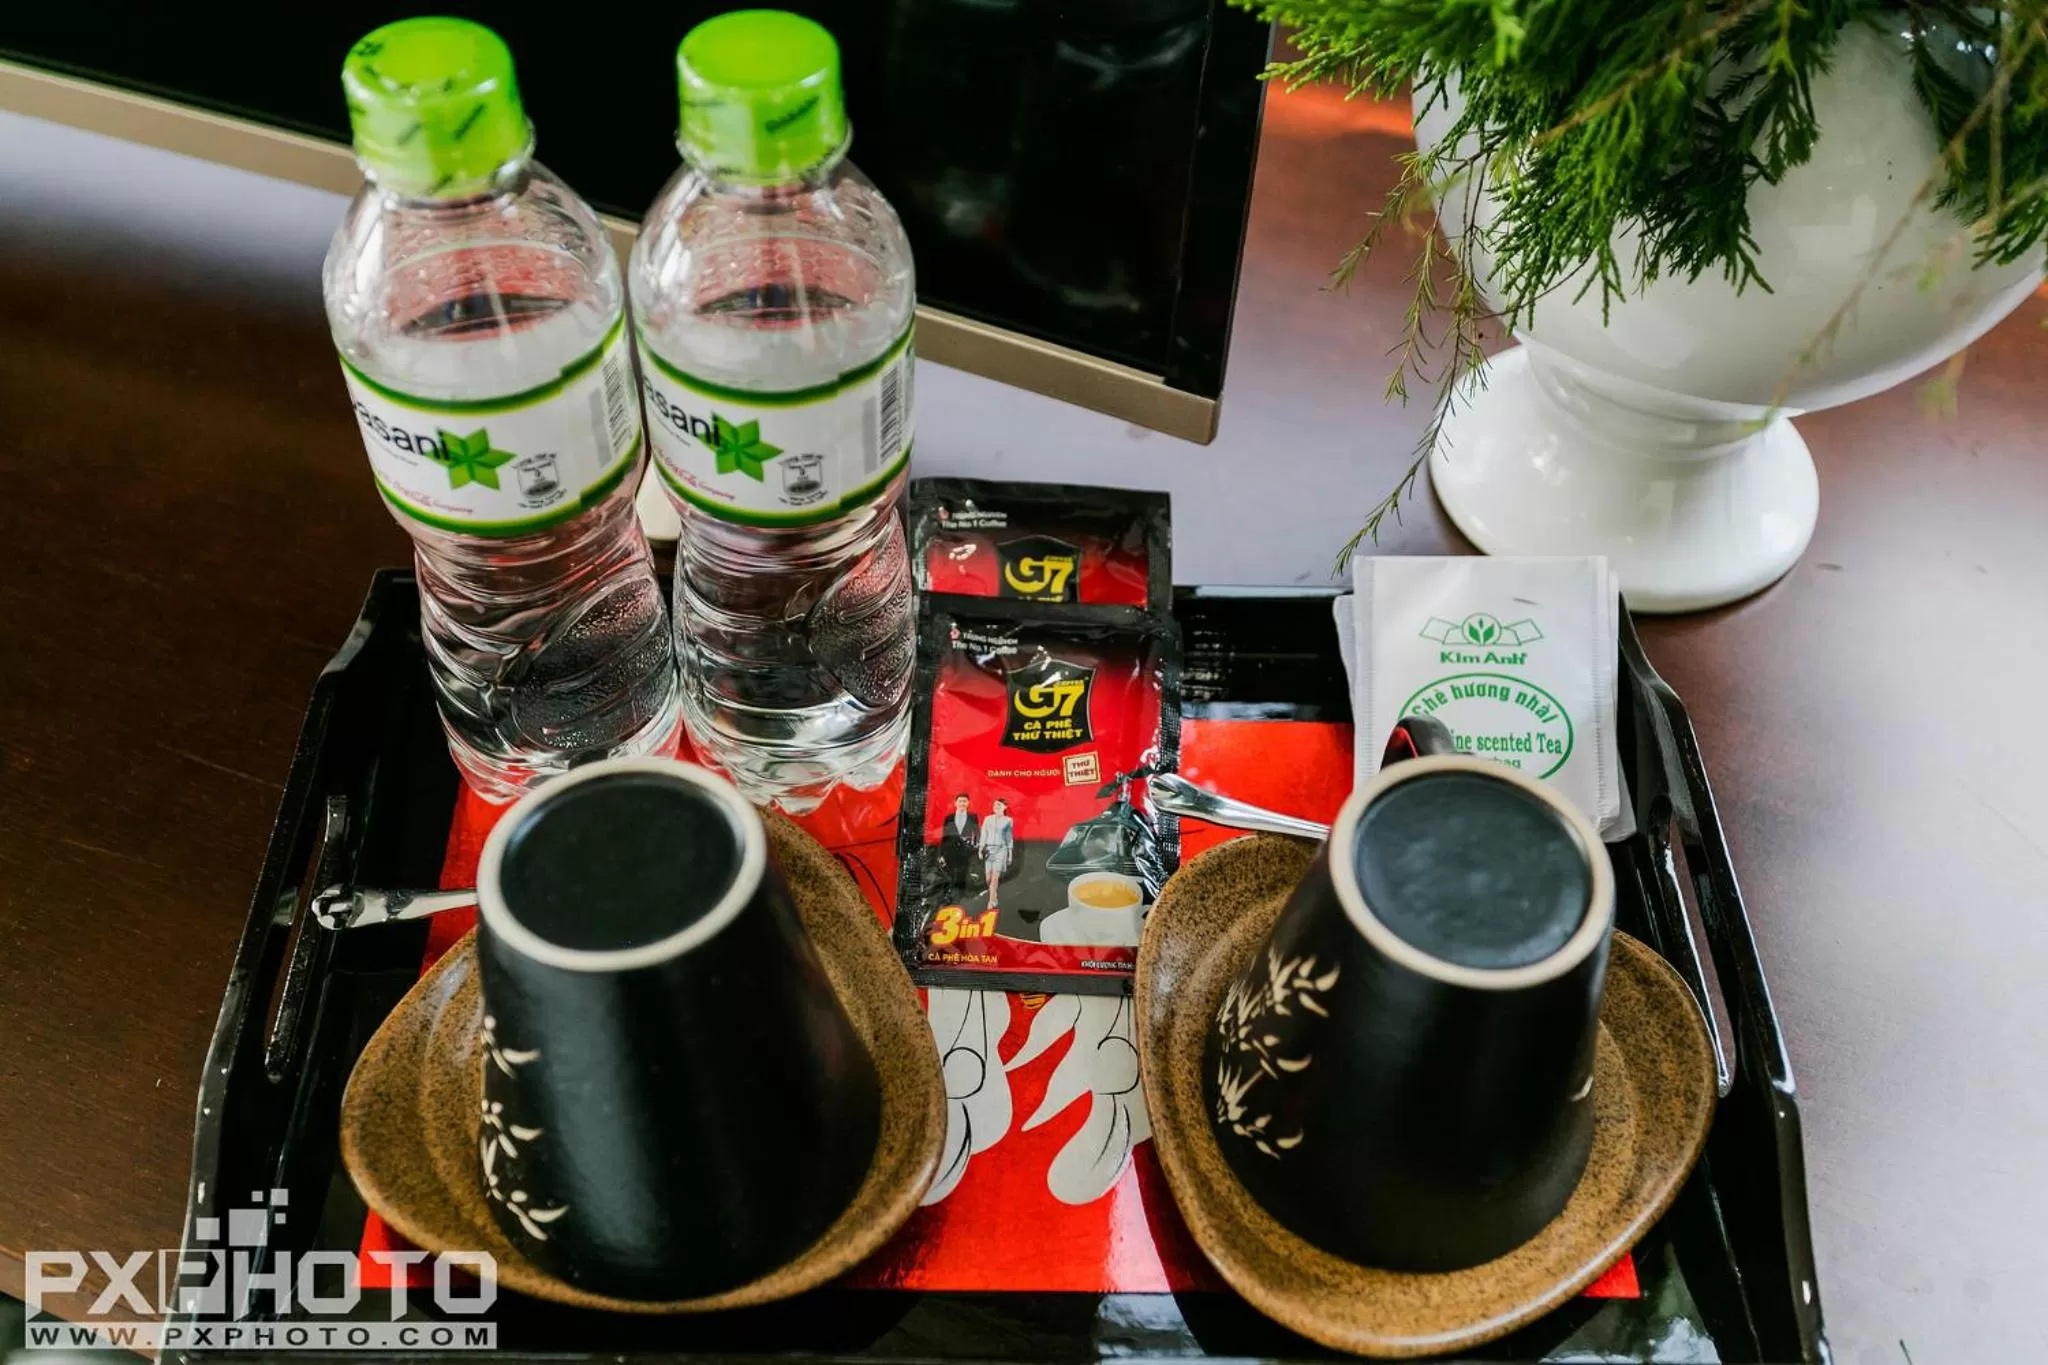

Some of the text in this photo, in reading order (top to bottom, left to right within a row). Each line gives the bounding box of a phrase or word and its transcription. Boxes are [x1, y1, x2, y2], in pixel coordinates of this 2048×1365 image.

[942, 519, 957, 529] The
[1004, 556, 1074, 594] G7
[952, 640, 968, 650] The
[1439, 651, 1481, 665] Kim
[1450, 682, 1511, 702] hương
[1013, 682, 1085, 719] G7
[1045, 717, 1073, 730] PHÊ
[1476, 731, 1532, 753] scented
[1536, 732, 1563, 755] Tea
[1013, 769, 1032, 777] CHO
[930, 907, 998, 945] 3in1
[980, 954, 998, 964] TAN
